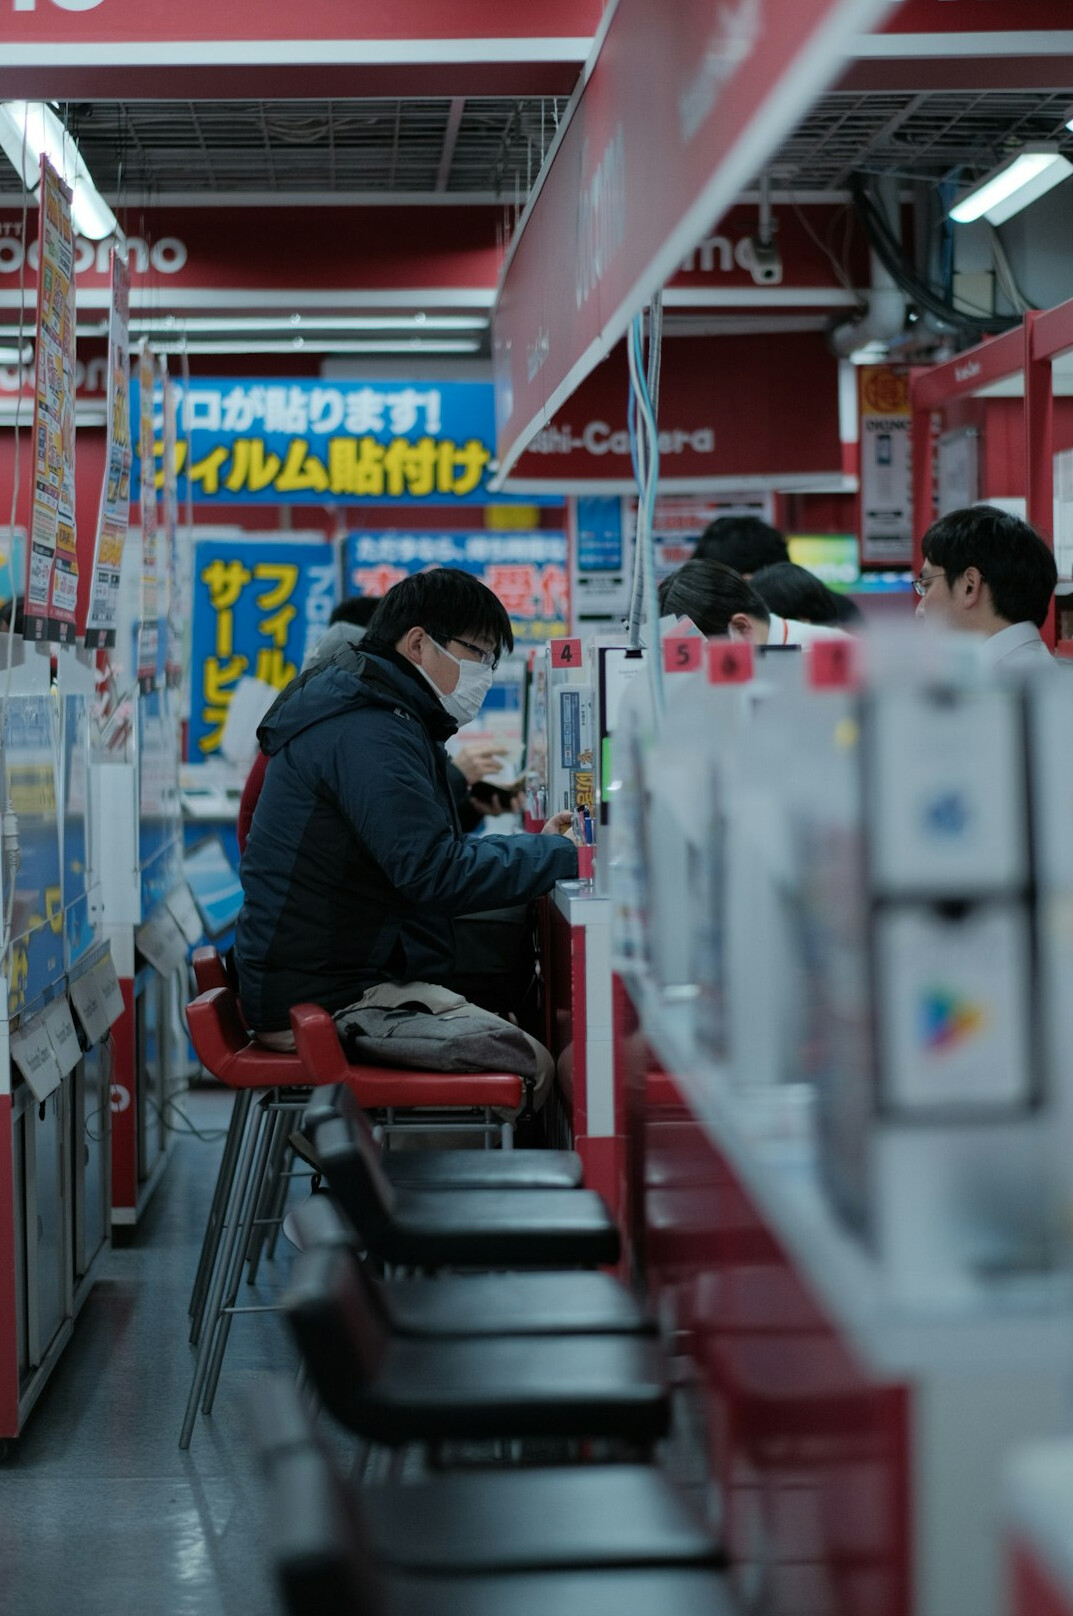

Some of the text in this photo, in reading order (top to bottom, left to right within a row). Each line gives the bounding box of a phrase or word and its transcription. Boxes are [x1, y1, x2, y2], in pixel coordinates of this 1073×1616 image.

[137, 435, 499, 495] フィルム貼付け
[560, 645, 572, 662] 4
[676, 645, 690, 666] 5
